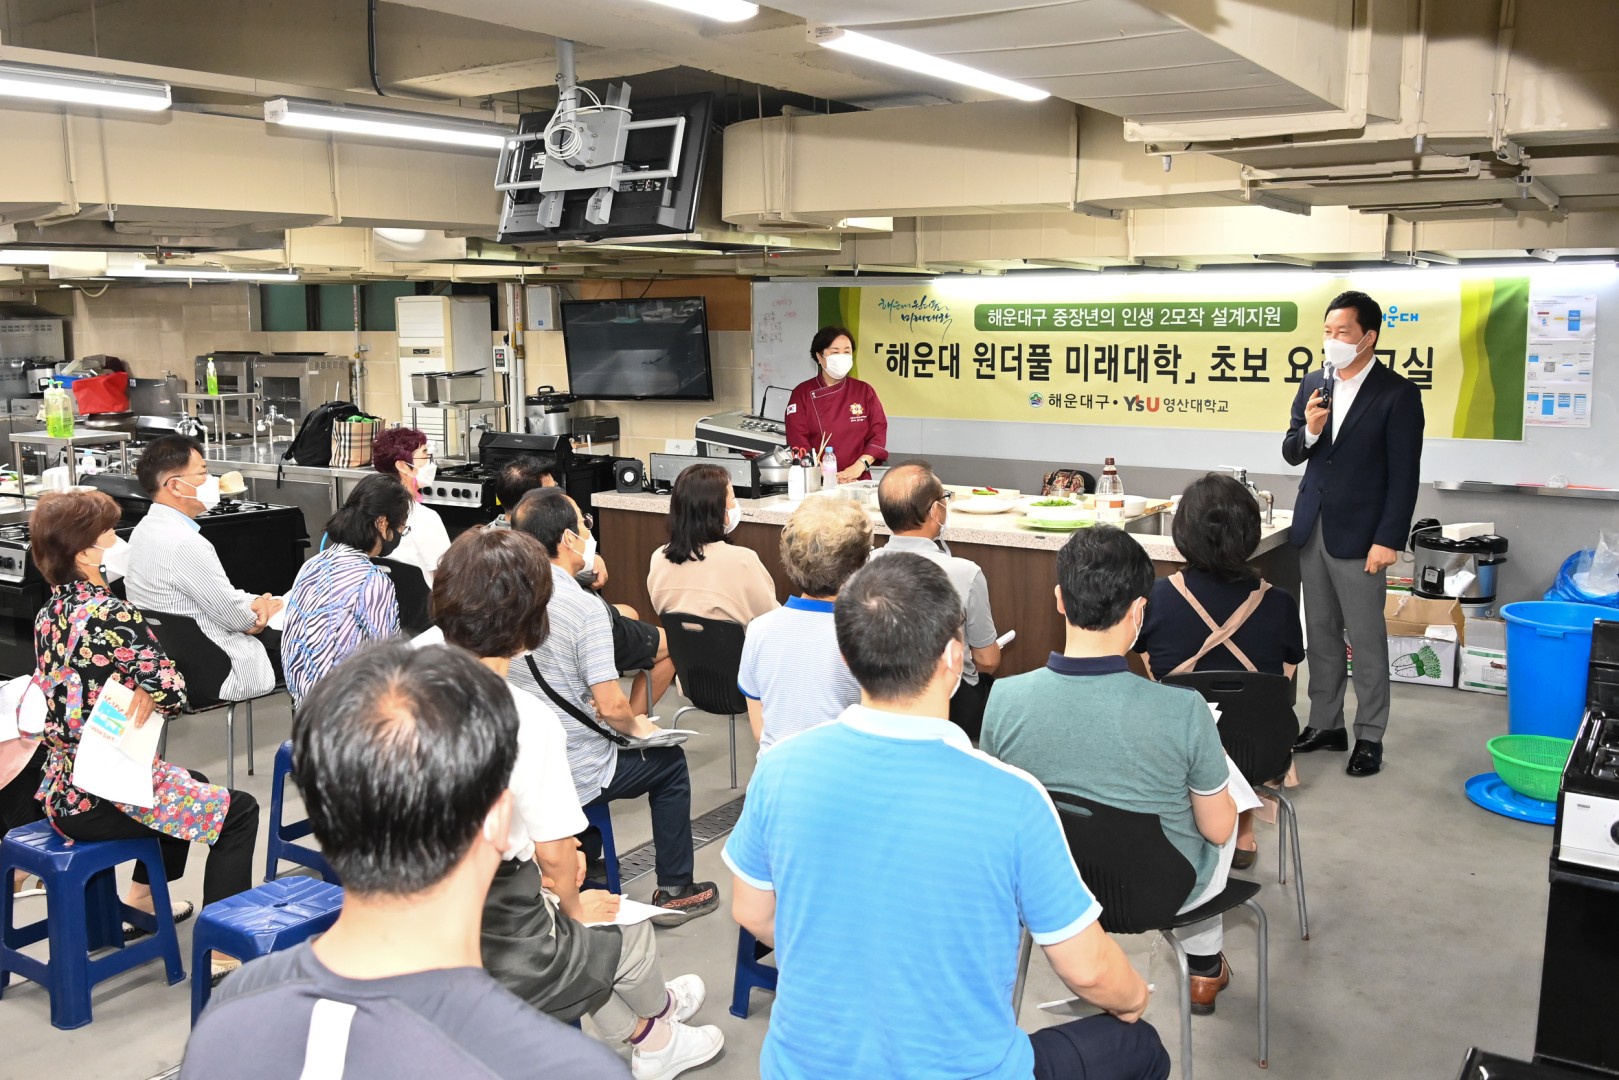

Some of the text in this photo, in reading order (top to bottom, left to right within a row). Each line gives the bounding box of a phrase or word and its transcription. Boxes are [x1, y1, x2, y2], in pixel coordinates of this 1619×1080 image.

[987, 306, 1281, 328] 해운대구 중장년의 인생 2모작 설계지원
[1382, 305, 1419, 328] 운대
[874, 342, 960, 380] 「해운대
[972, 342, 1053, 382] 원더풀
[1065, 343, 1196, 385] 미래대학」
[1207, 345, 1271, 383] 초보
[1163, 397, 1229, 413] 영산대학교
